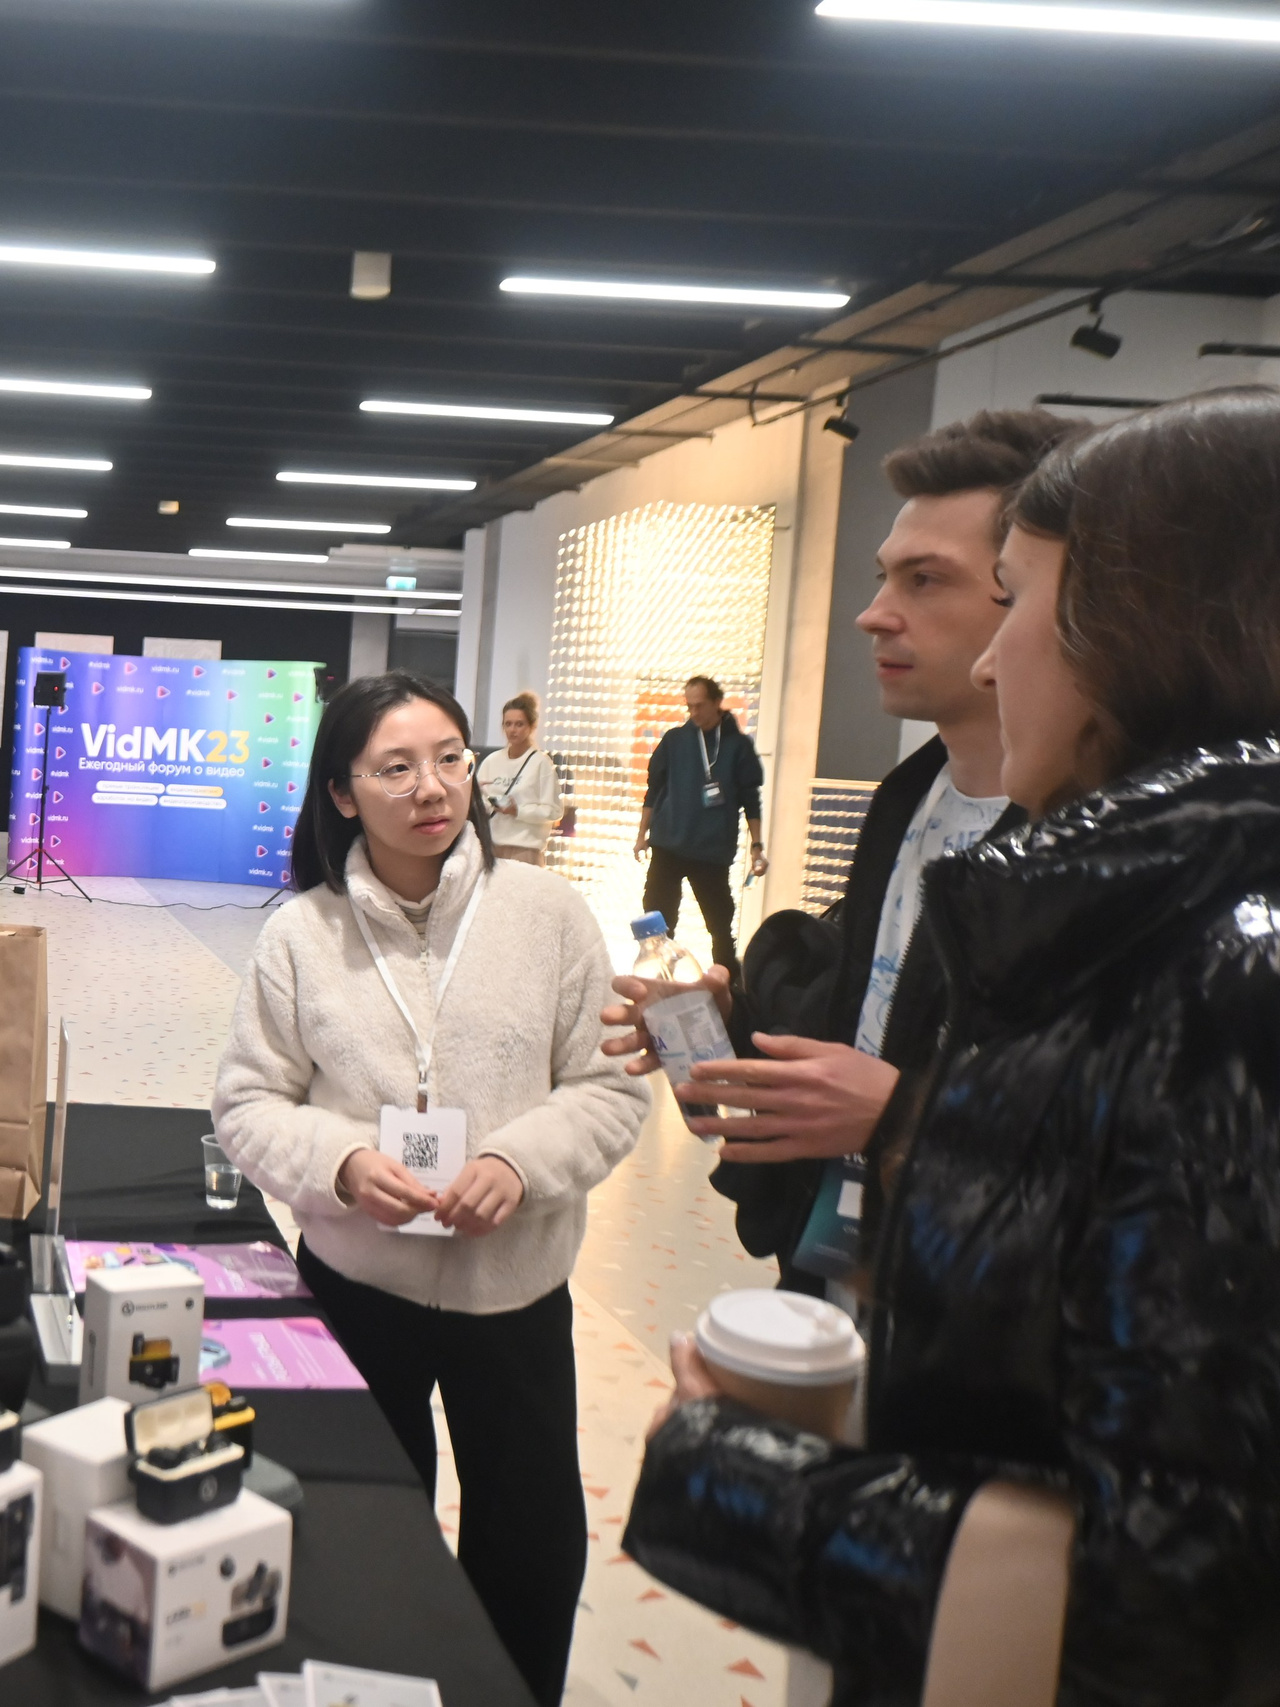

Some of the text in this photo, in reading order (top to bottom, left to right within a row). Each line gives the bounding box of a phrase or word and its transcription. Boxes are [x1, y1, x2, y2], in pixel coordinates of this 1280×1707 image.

[151, 664, 180, 673] vidmk.ru
[81, 722, 250, 763] VidMK23
[78, 757, 245, 778] Ежегодный форум о видео
[47, 814, 69, 822] vidmk.ru
[248, 867, 274, 877] vidmk.ru
